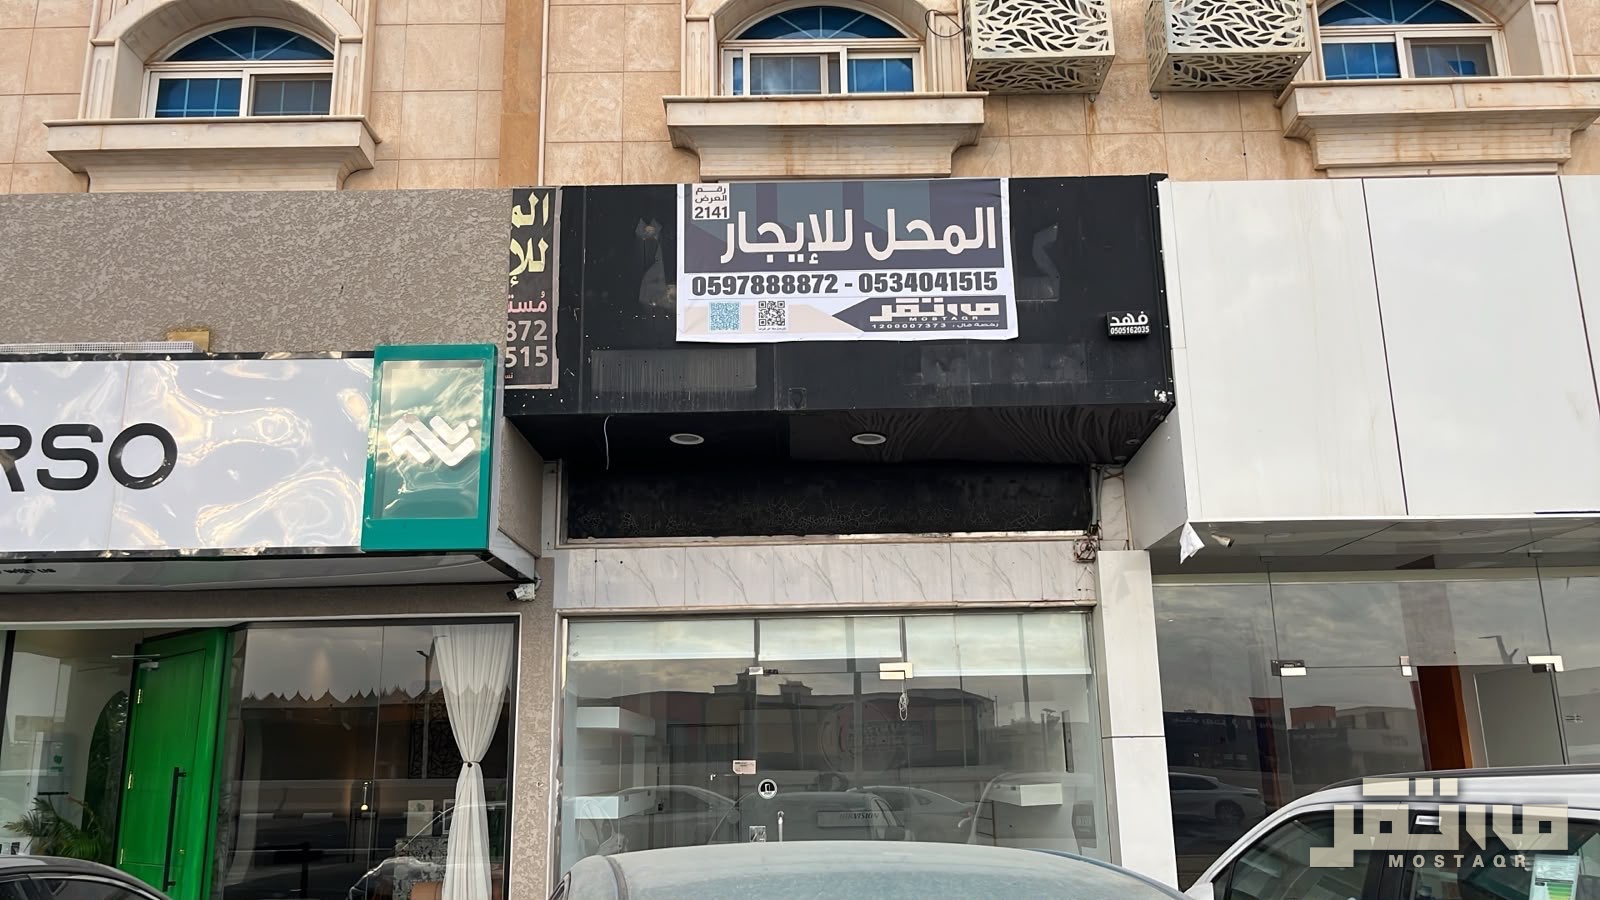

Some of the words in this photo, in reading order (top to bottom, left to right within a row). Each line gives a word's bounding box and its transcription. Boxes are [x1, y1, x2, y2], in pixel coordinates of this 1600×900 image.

[695, 185, 726, 196] رقم
[695, 194, 727, 204] العرض
[694, 206, 727, 219] 2141
[720, 209, 853, 264] للإيجار
[864, 206, 997, 261] المحل
[691, 273, 839, 296] 0597888872
[858, 271, 998, 293] 0534041515
[506, 320, 548, 342] 872
[505, 345, 548, 368] 515
